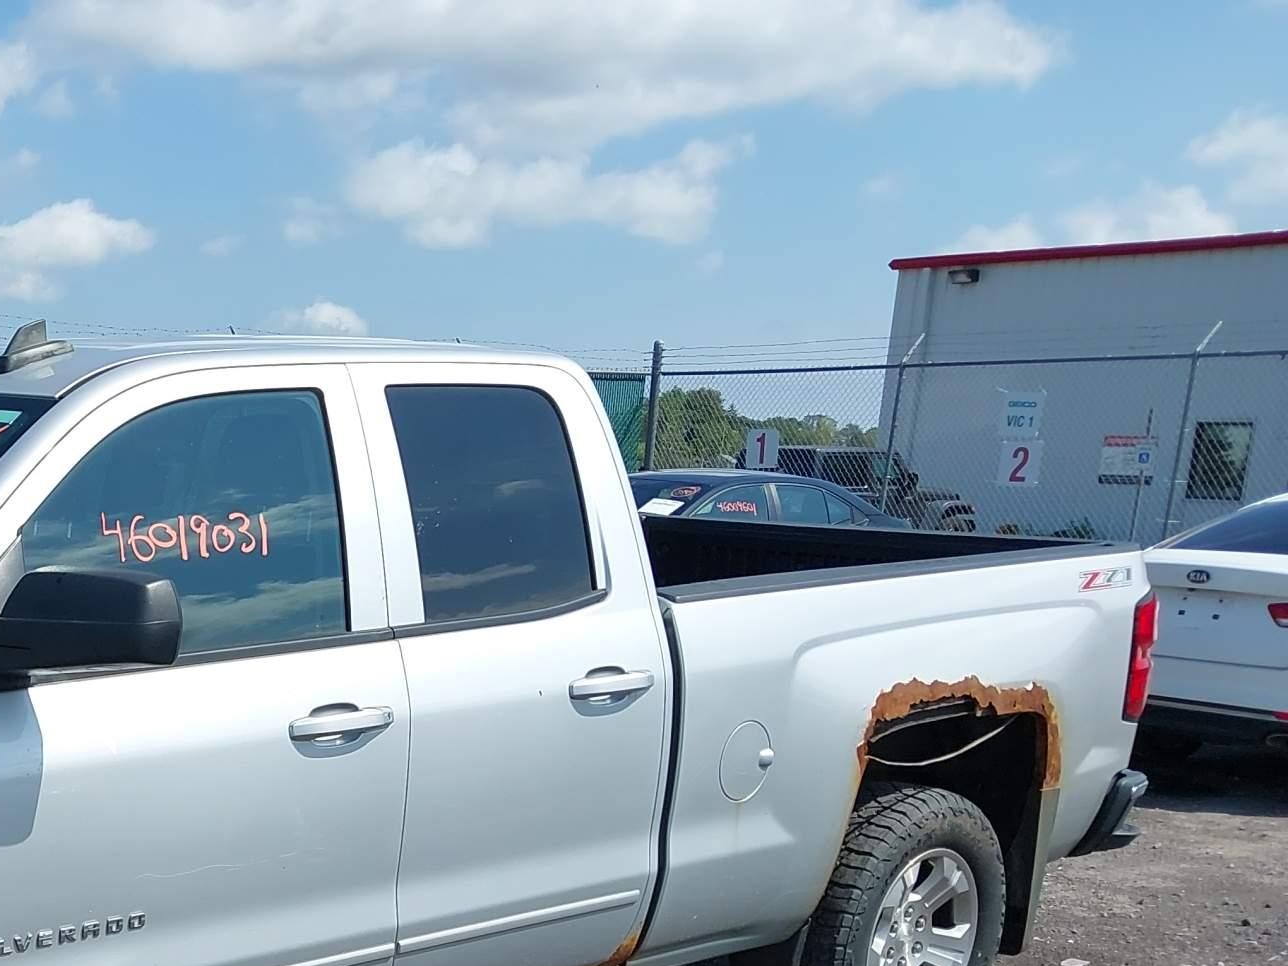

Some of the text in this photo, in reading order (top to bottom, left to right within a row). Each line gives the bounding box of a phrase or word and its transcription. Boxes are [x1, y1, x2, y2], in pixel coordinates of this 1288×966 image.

[1007, 415, 1025, 428] VIC
[756, 432, 766, 465] 1
[1008, 446, 1030, 482] 2
[100, 511, 268, 563] 46019031
[1078, 566, 1133, 592] Z71
[1187, 570, 1210, 583] KIA
